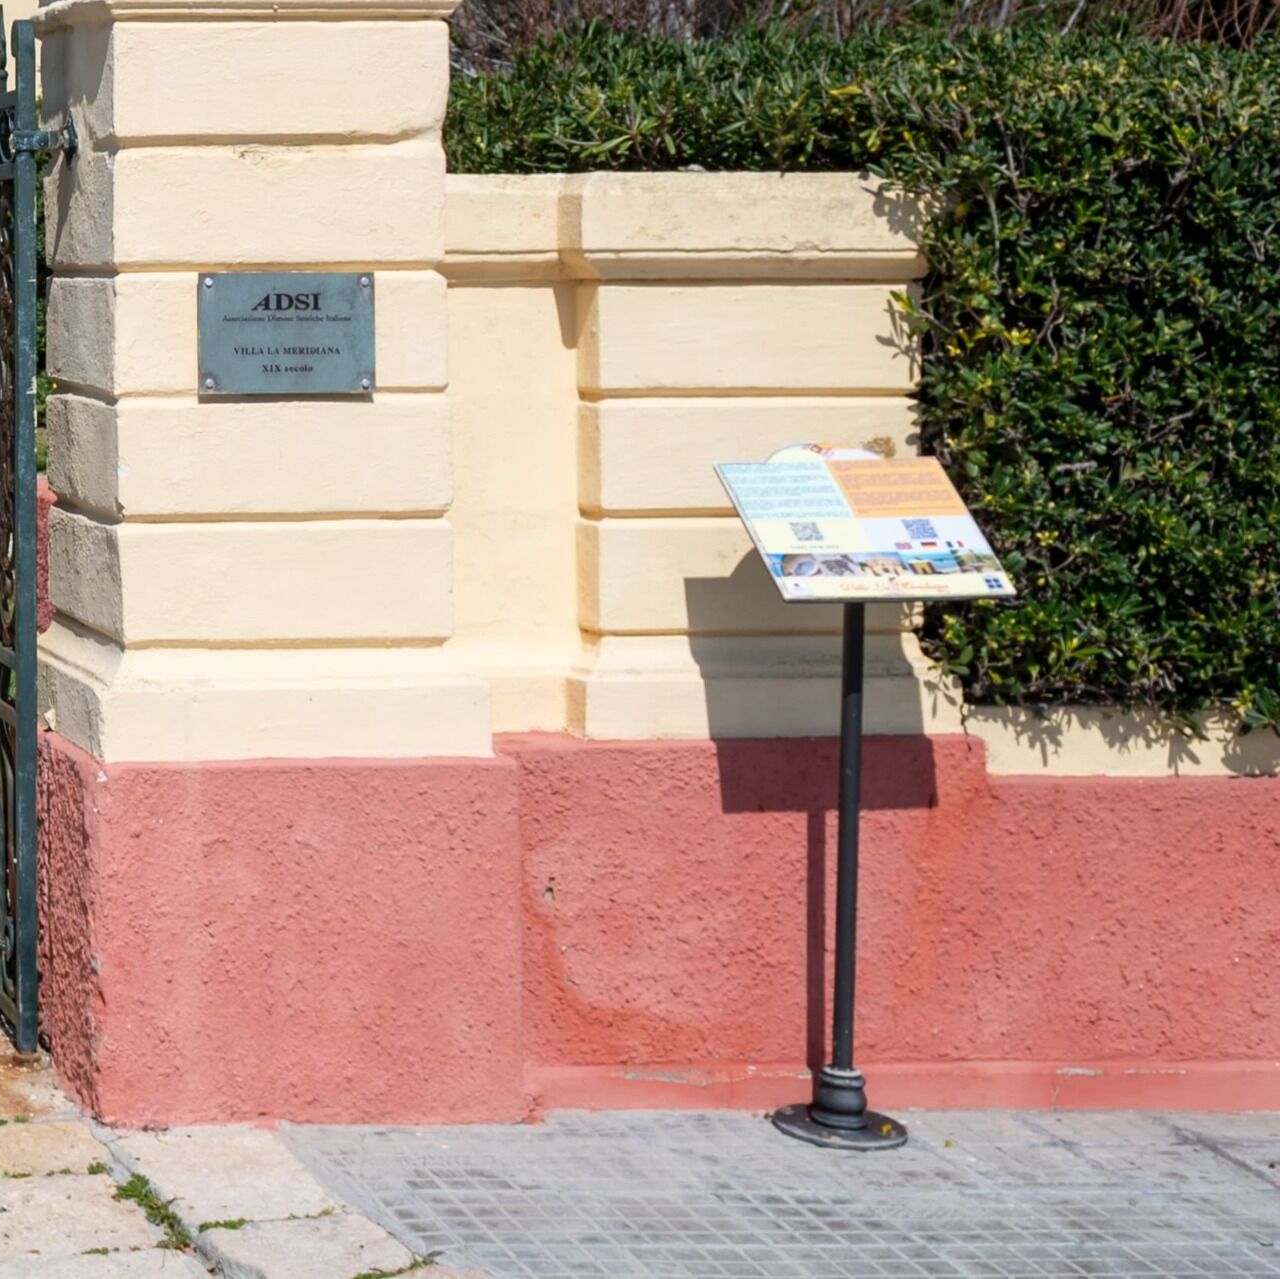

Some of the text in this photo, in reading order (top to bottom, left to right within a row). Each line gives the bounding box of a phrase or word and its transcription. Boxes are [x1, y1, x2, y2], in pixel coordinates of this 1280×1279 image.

[251, 292, 322, 311] ADSI
[233, 347, 341, 355] VILLA LA MERIDIANA
[261, 364, 313, 373] XIX secolo
